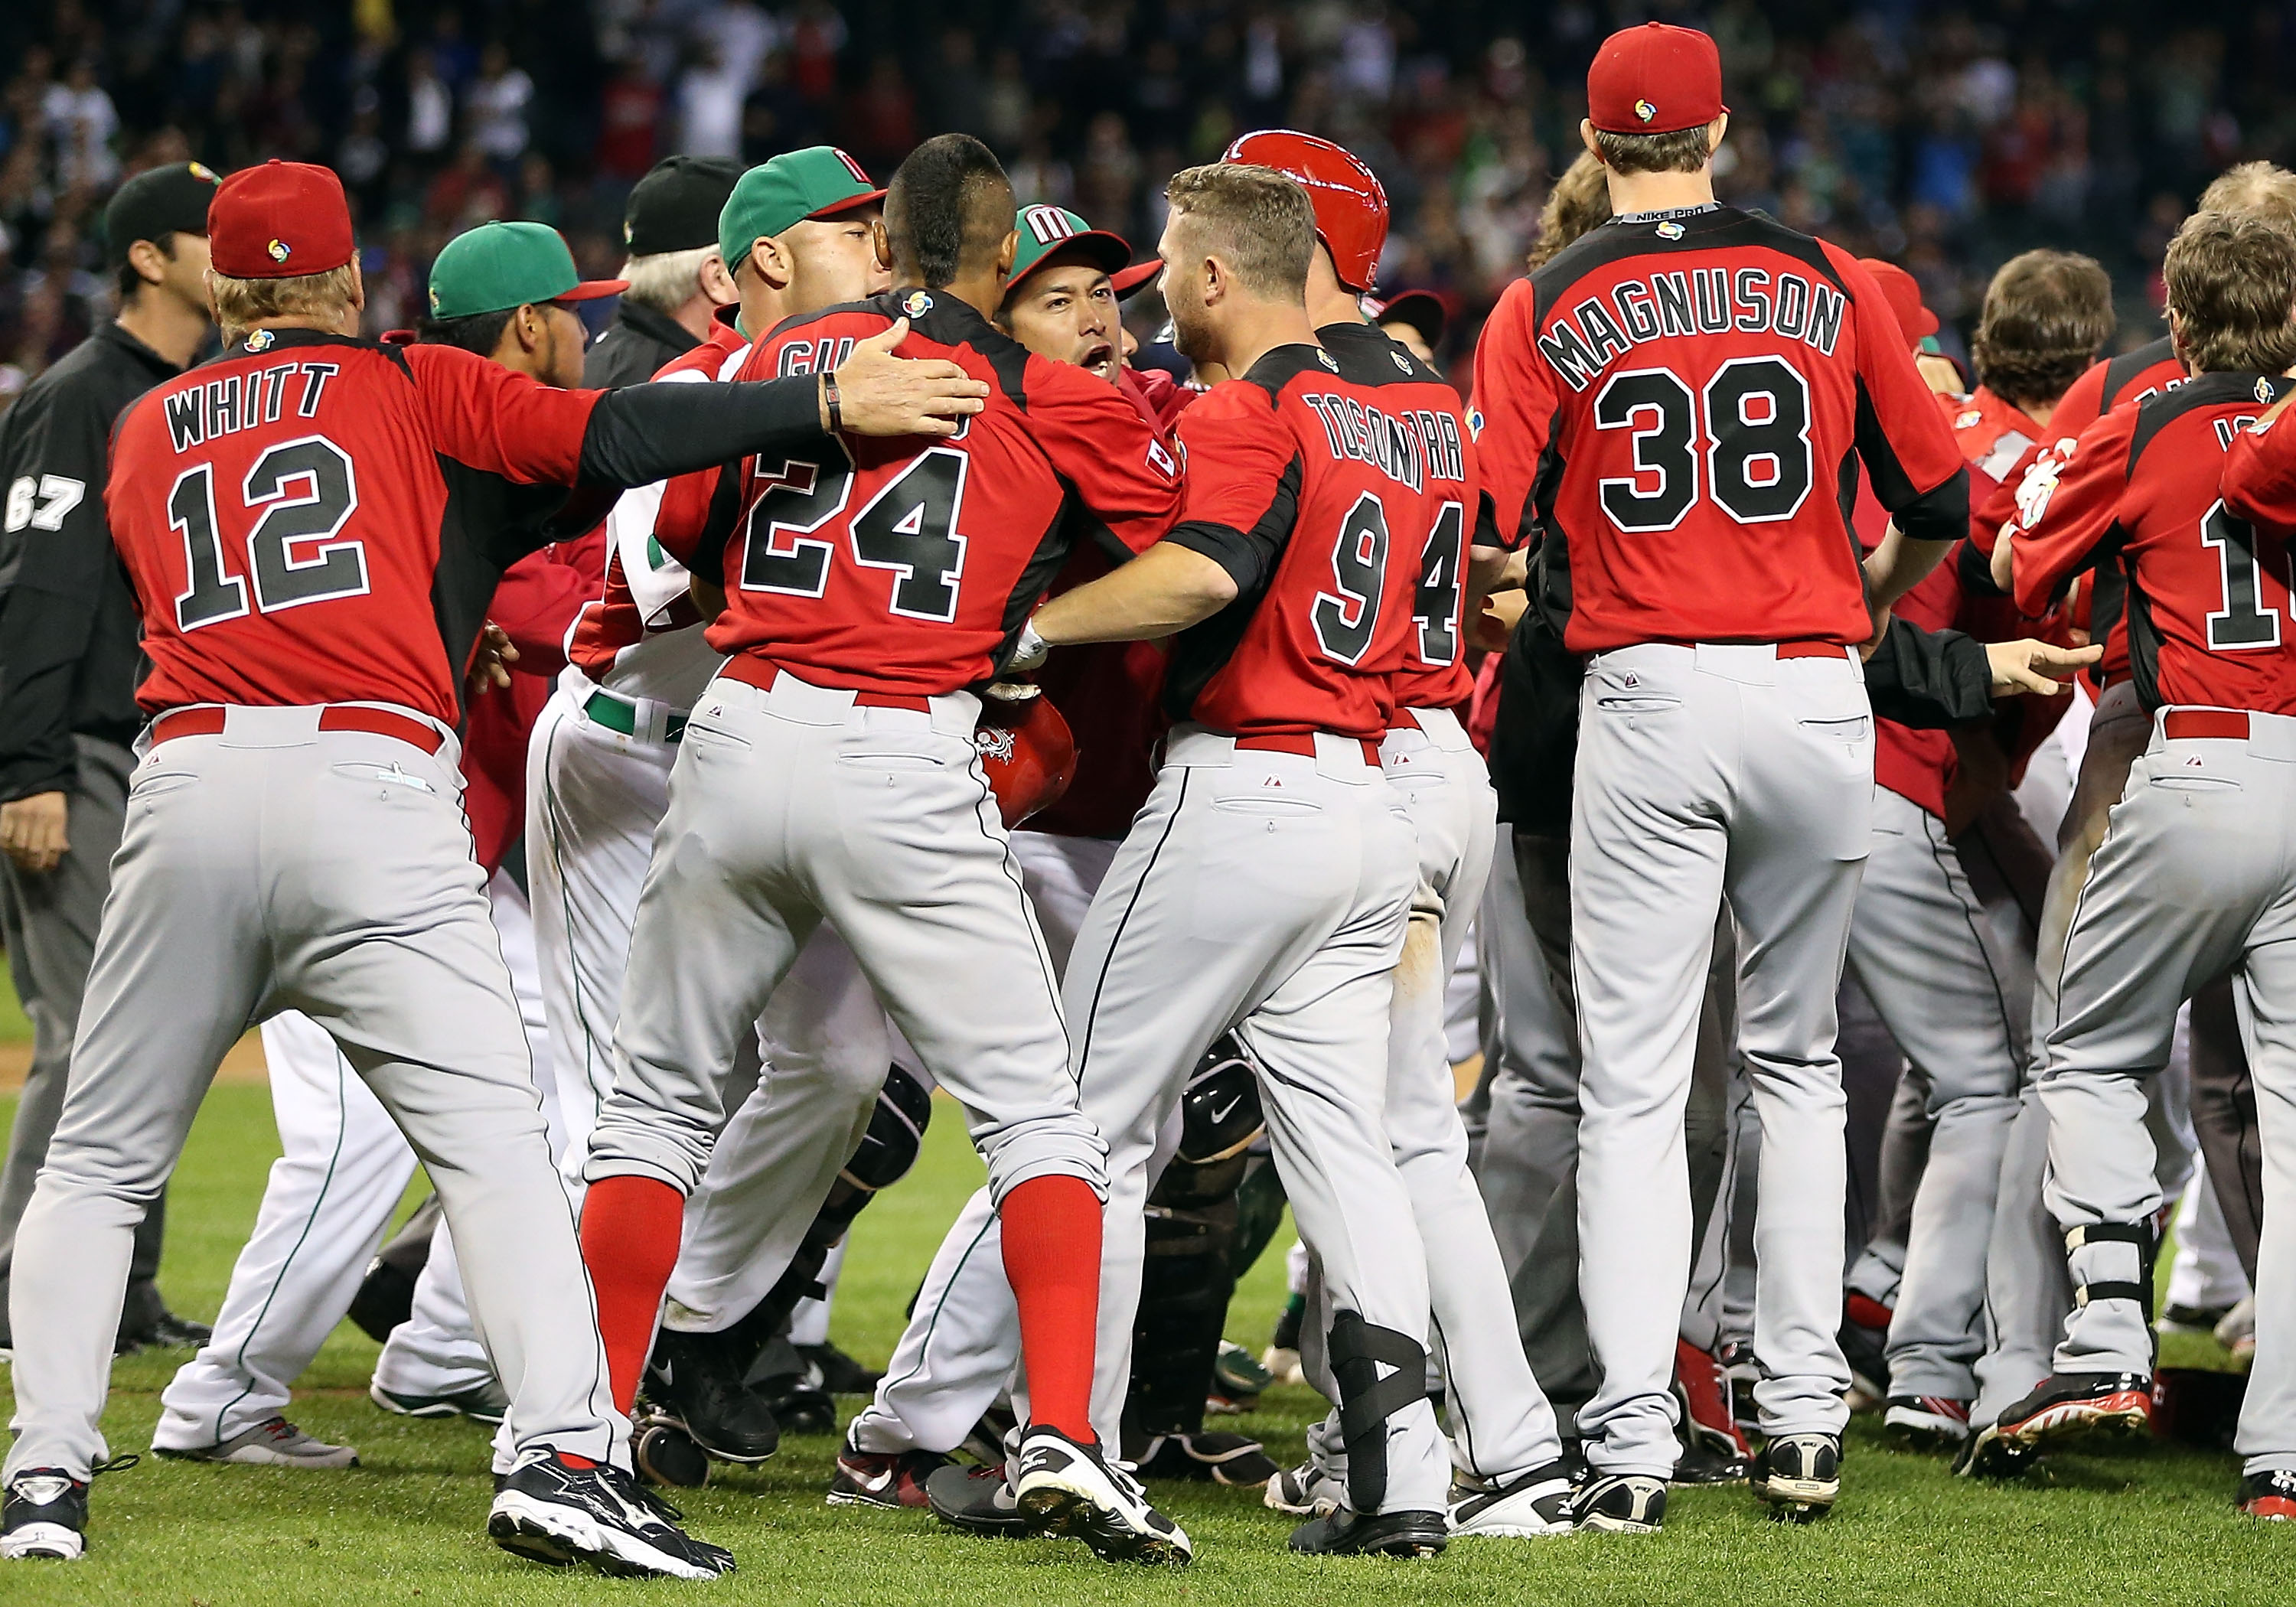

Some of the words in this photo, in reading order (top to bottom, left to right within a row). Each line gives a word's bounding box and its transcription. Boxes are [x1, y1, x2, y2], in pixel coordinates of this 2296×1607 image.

[1636, 211, 1669, 221] NIKE
[1675, 206, 1704, 218] PRO
[164, 362, 340, 454] WHITT
[1538, 267, 1845, 393] MAGNUSON
[4, 474, 86, 533] 67
[1593, 354, 1813, 533] 38
[167, 434, 370, 633] 12
[740, 435, 970, 624] 24
[1309, 490, 1390, 667] 9
[1412, 500, 1463, 667] 4
[2199, 497, 2296, 650] 1
